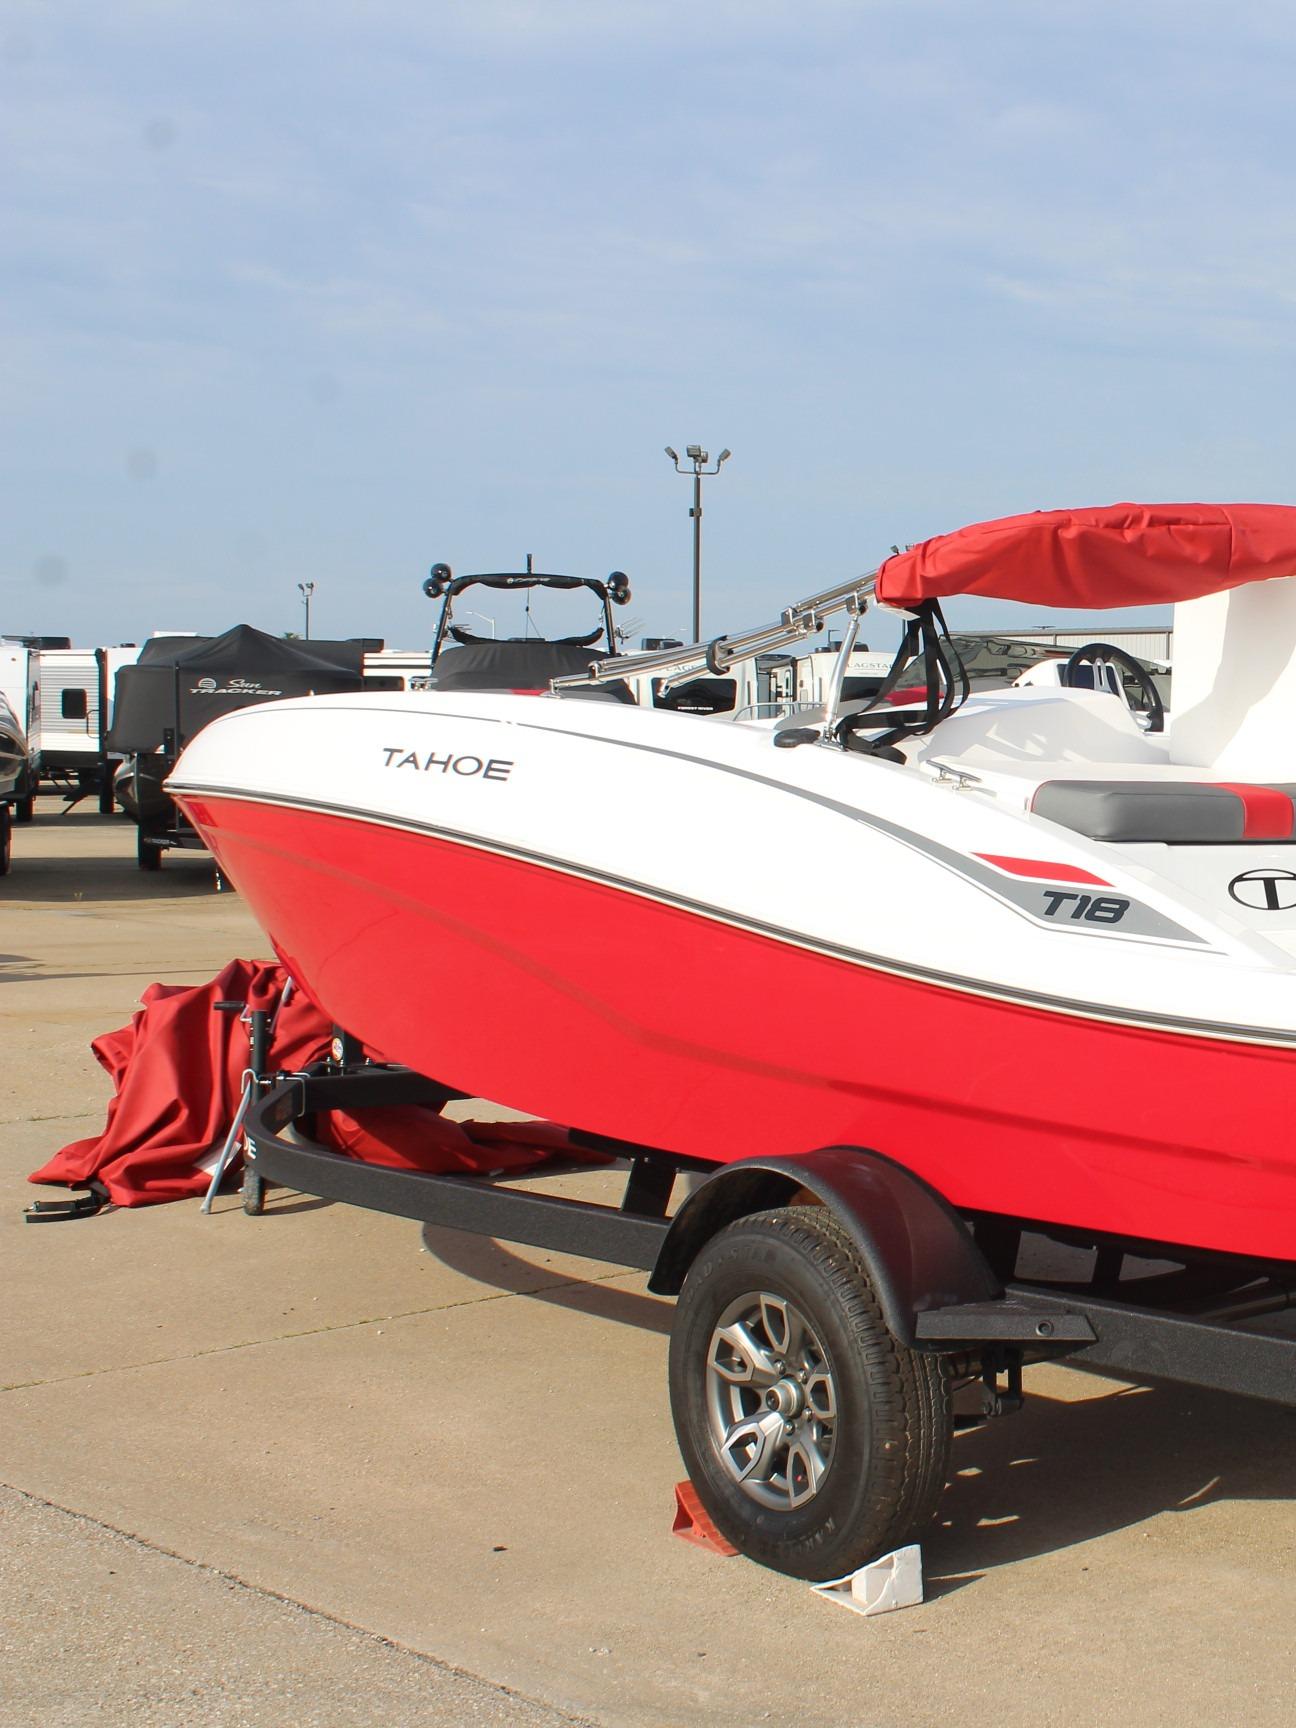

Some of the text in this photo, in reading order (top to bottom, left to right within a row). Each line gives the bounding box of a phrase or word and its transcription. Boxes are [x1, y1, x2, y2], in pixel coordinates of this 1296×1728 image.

[190, 688, 283, 696] TRACKER
[383, 747, 514, 781] TAHOE
[1043, 890, 1130, 924] T18
